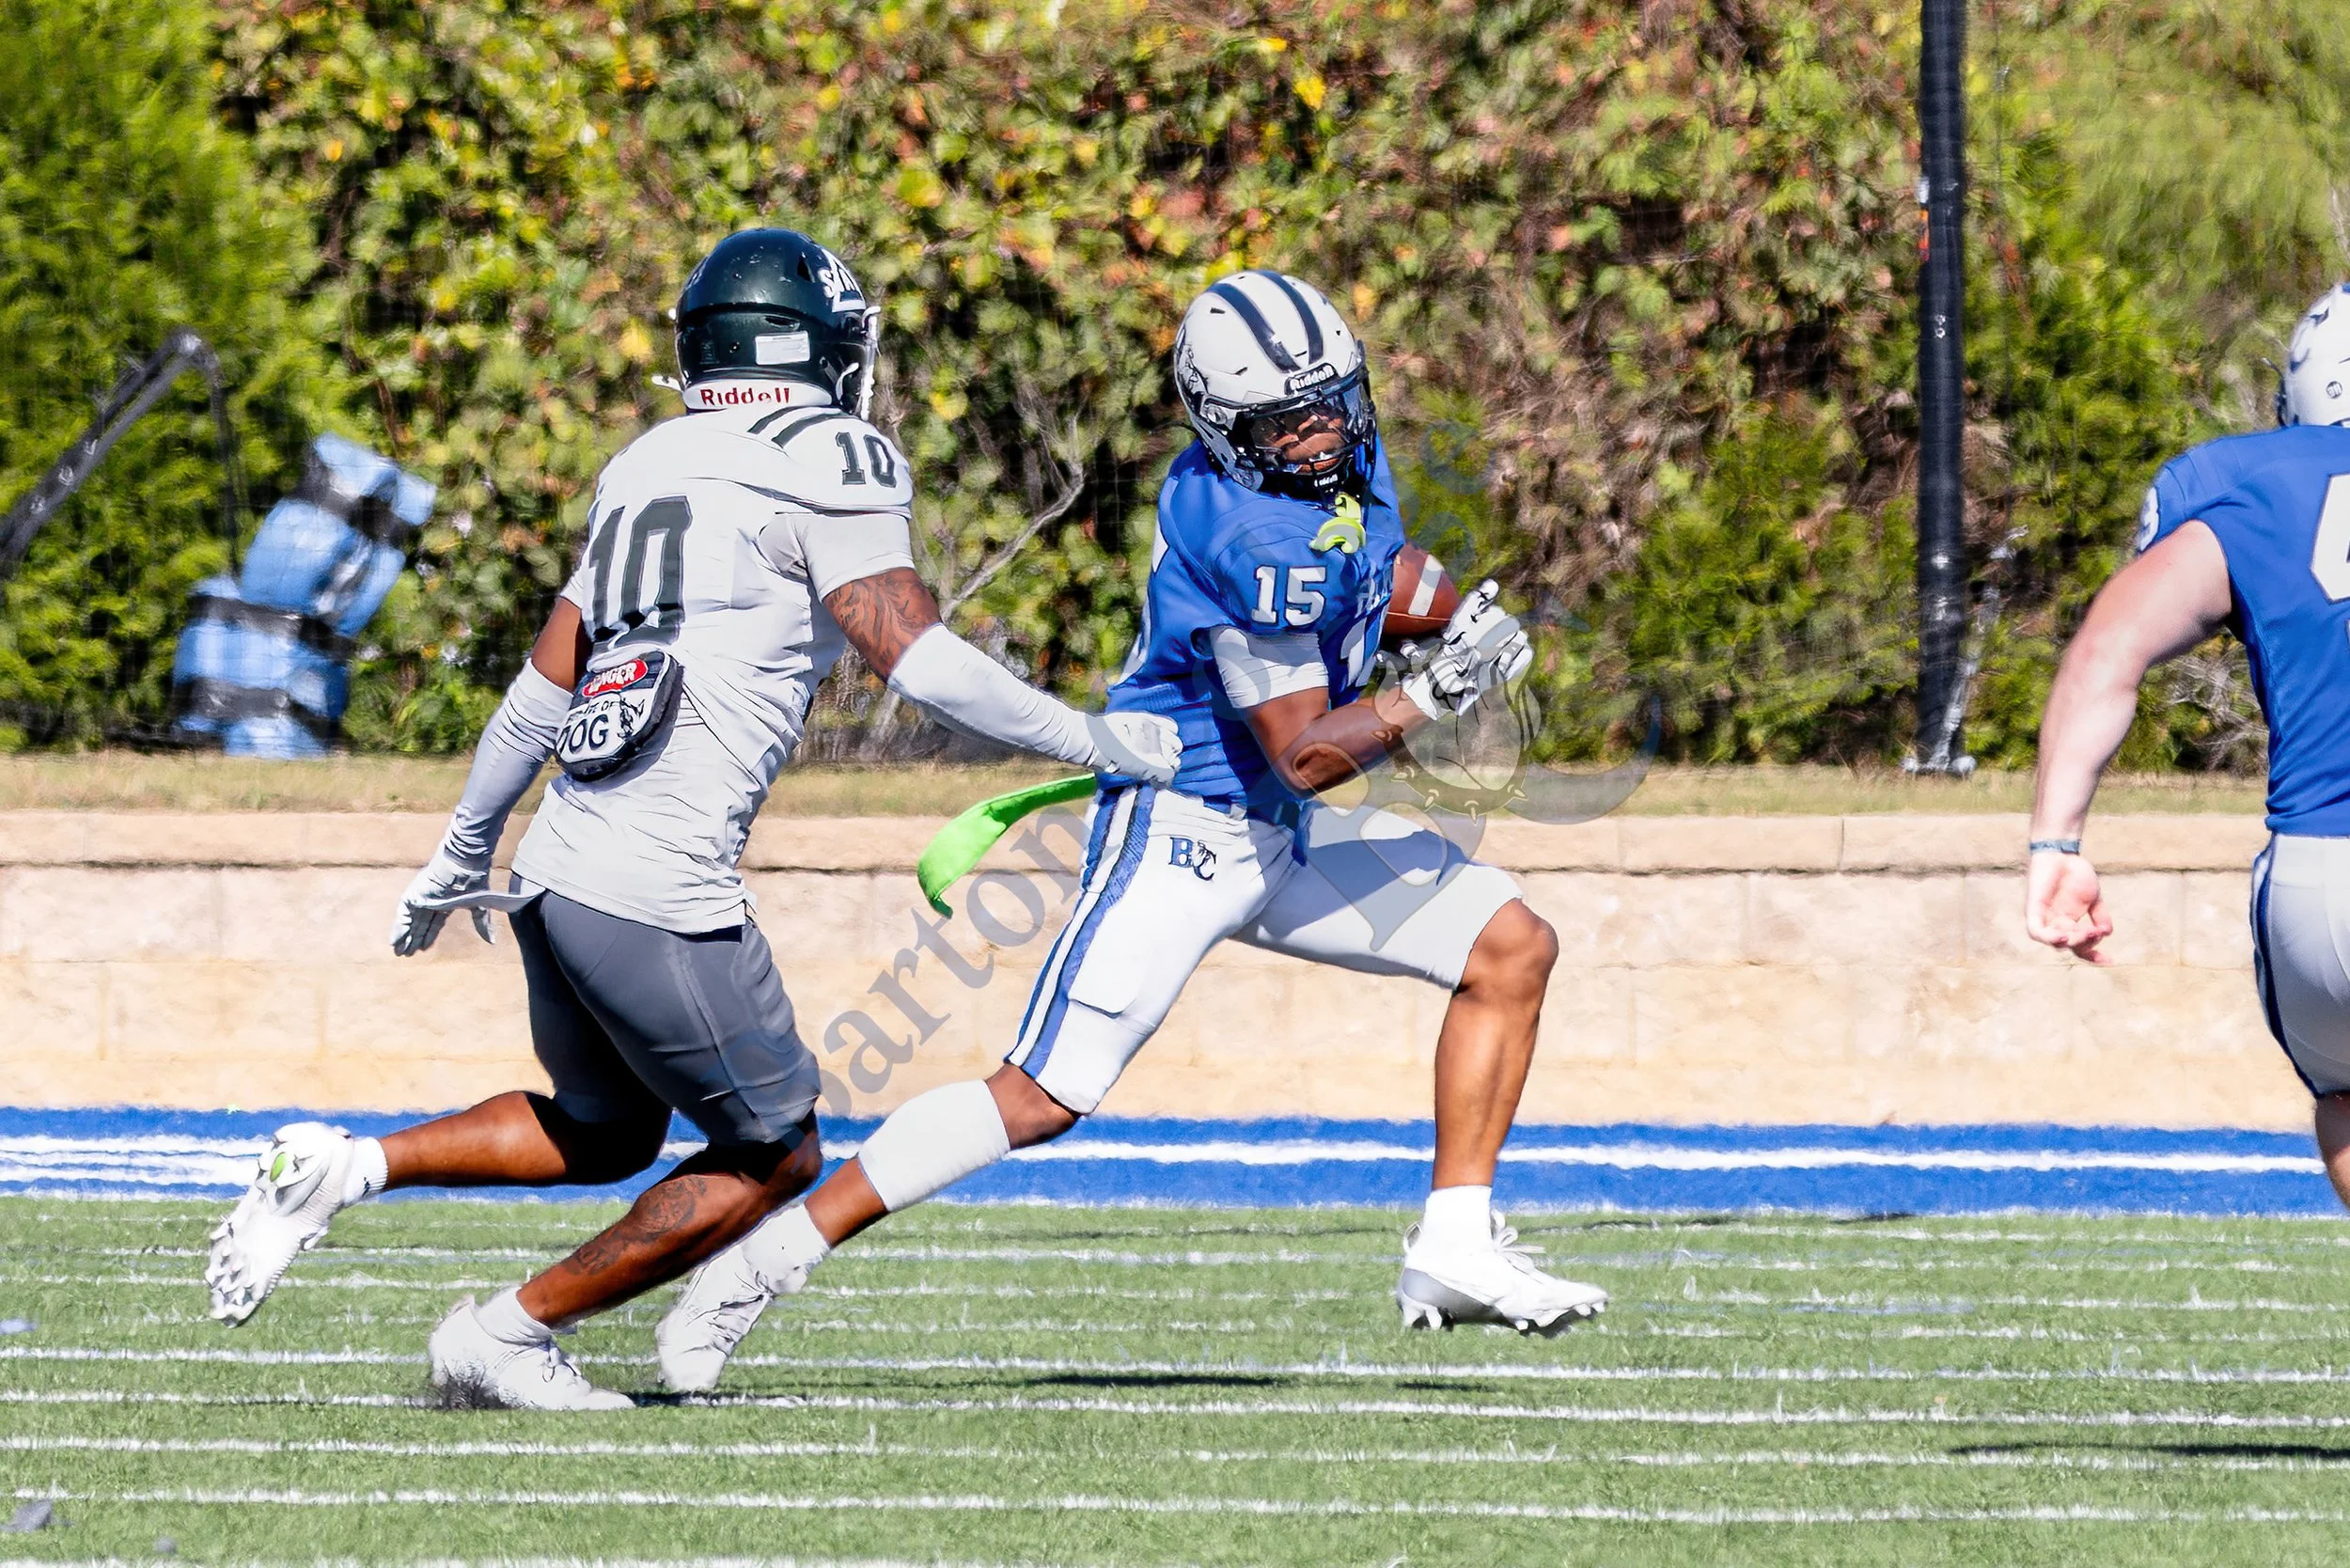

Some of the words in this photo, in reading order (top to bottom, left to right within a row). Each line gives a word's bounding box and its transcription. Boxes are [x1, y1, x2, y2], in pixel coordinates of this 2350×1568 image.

[700, 386, 790, 406] Riddell
[835, 431, 898, 489] 10
[588, 494, 694, 650] 10
[1251, 565, 1327, 627] 15
[1168, 837, 1217, 882] BC
